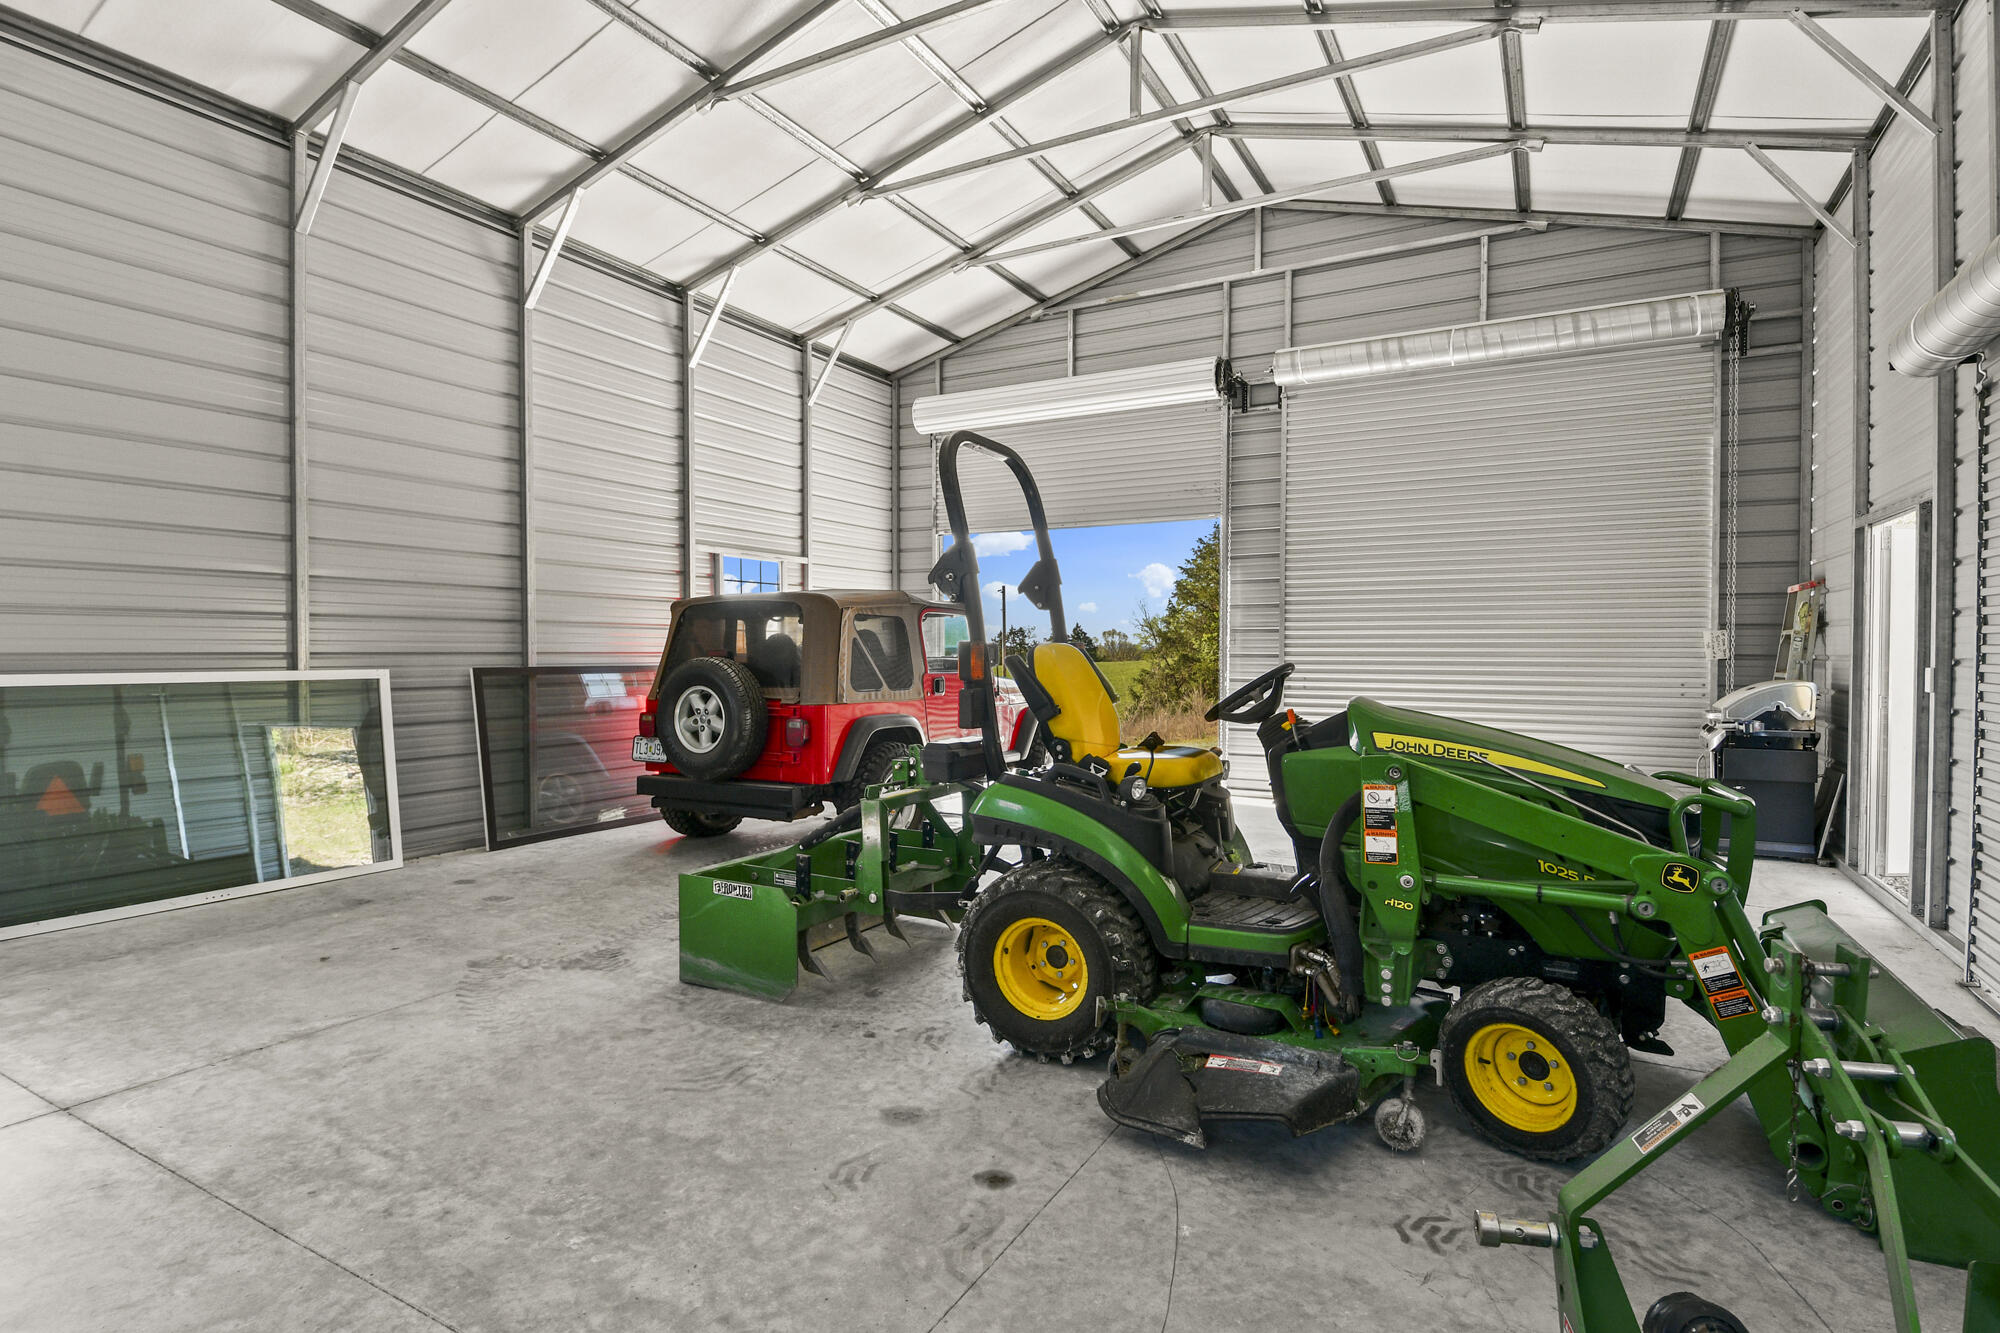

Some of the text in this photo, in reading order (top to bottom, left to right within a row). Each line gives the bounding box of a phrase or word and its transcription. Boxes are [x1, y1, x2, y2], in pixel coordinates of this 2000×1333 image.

[635, 742, 648, 755] TL3
[1385, 738, 1489, 761] JOHN DEERE
[1537, 859, 1579, 881] 1025
[721, 882, 752, 899] FRONTIER
